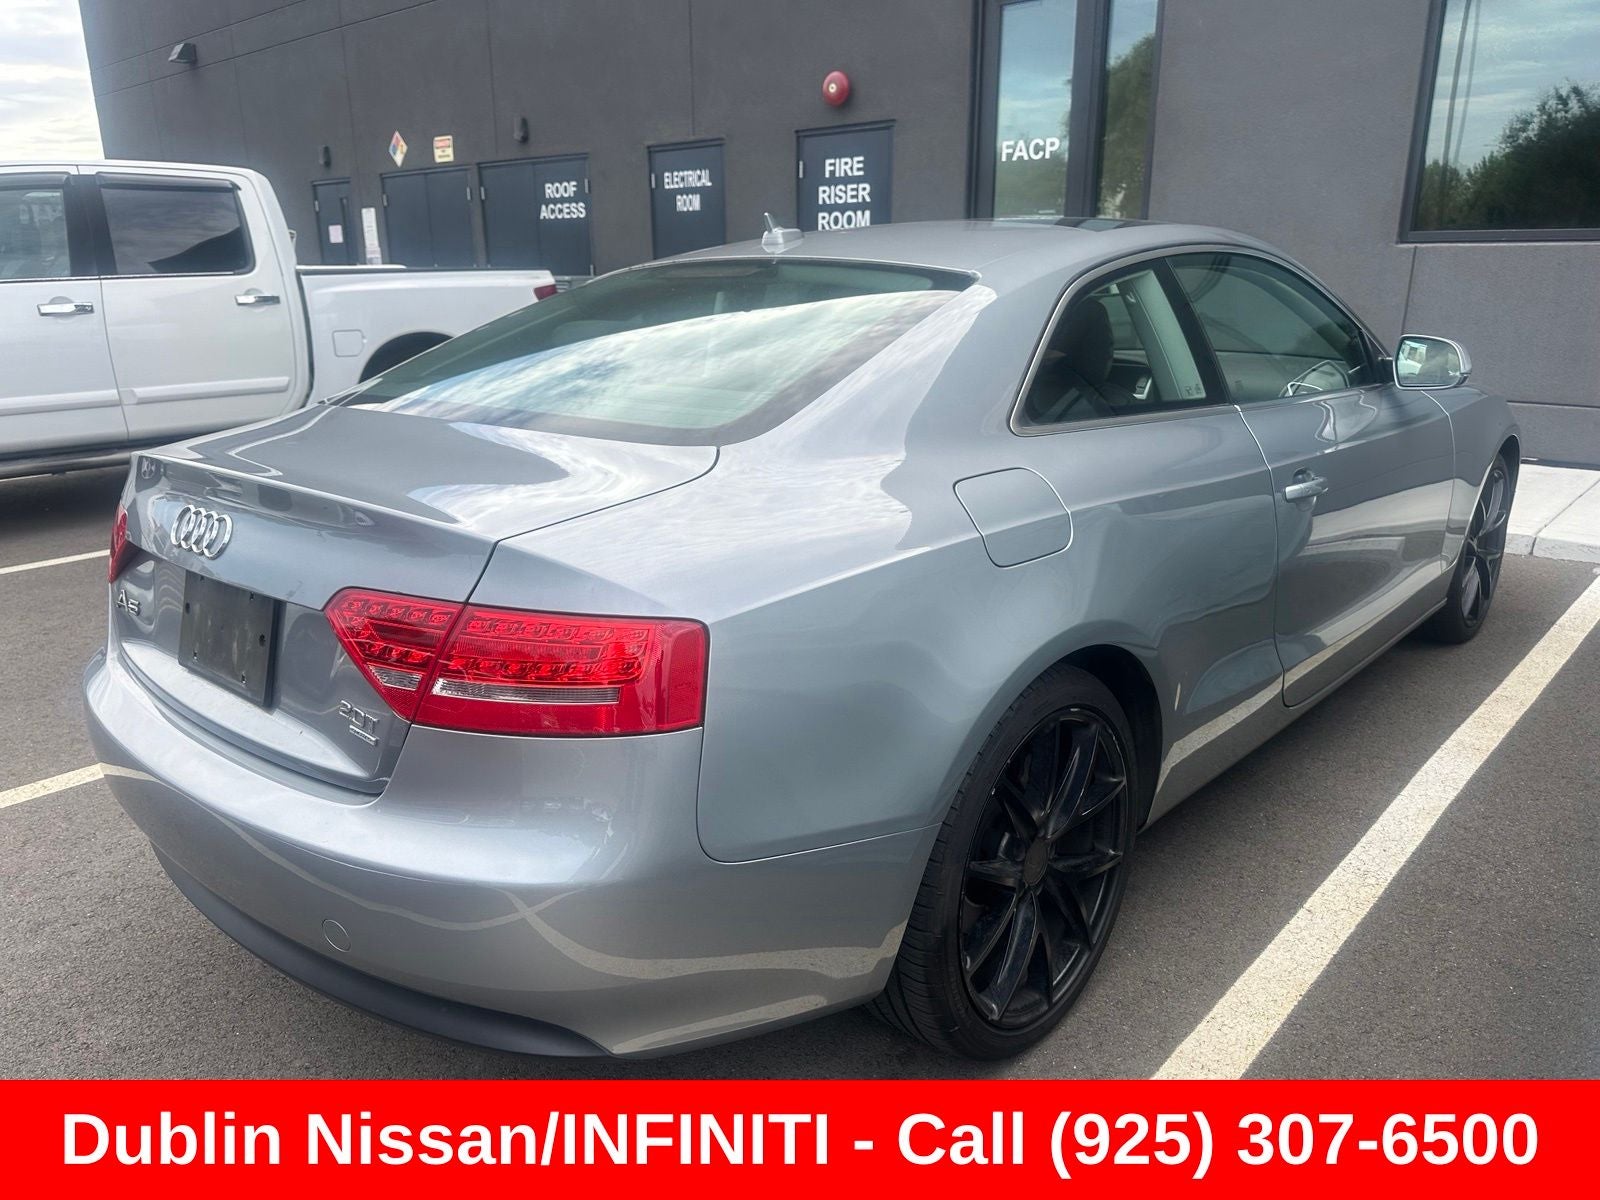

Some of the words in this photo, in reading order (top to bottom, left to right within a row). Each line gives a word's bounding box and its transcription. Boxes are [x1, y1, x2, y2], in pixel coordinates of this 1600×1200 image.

[1001, 137, 1060, 162] FACP
[824, 156, 865, 178] FIRE
[544, 180, 578, 199] ROOF
[663, 169, 713, 191] ELECTRICAL
[675, 193, 701, 213] ROOM
[818, 183, 871, 205] RISER
[539, 201, 587, 220] ACCESS
[817, 210, 871, 231] ROOM
[116, 589, 140, 616] A5
